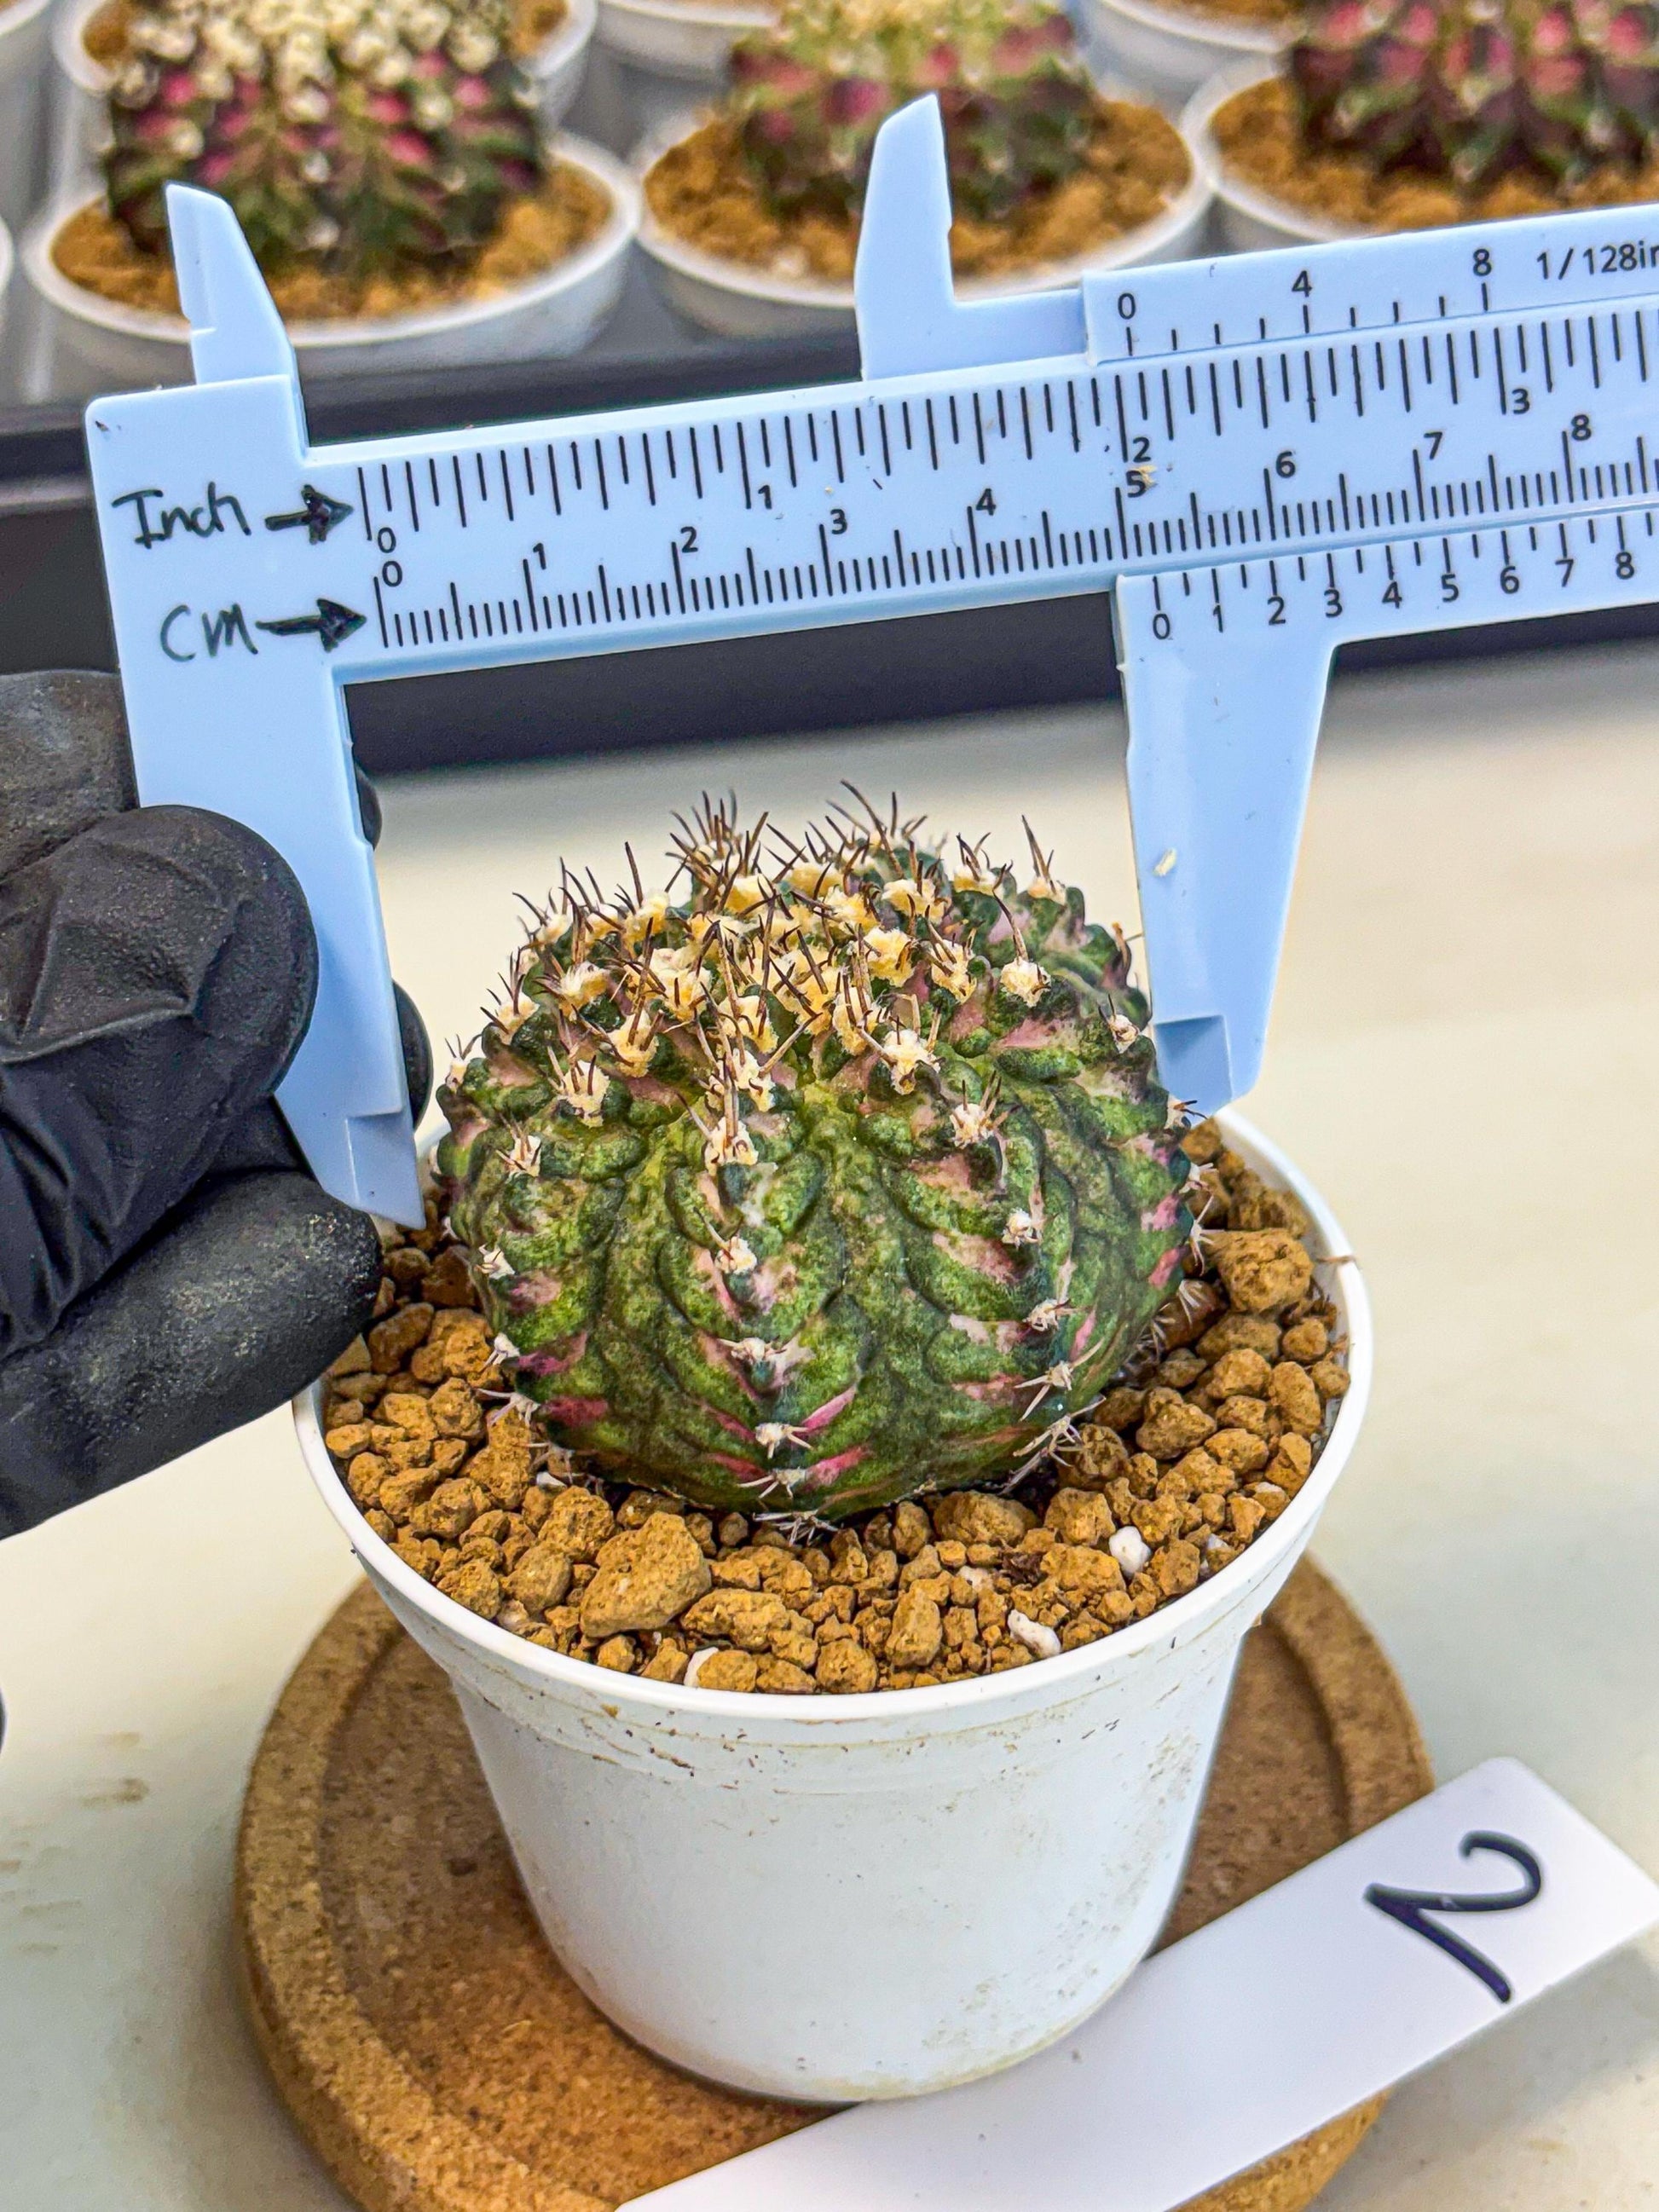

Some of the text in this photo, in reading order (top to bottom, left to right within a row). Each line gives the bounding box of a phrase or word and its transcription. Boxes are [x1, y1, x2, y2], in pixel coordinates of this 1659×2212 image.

[1117, 248, 1493, 321] 0 4 8
[112, 482, 251, 550] Inch
[377, 388, 1531, 554] 0 1 2 3
[381, 413, 1593, 587] 0 1 2 3 4 5 6 7 8
[1152, 552, 1636, 641] 0 1 2 3 4 5 6 7 8
[1364, 1829, 1543, 2003] 2
